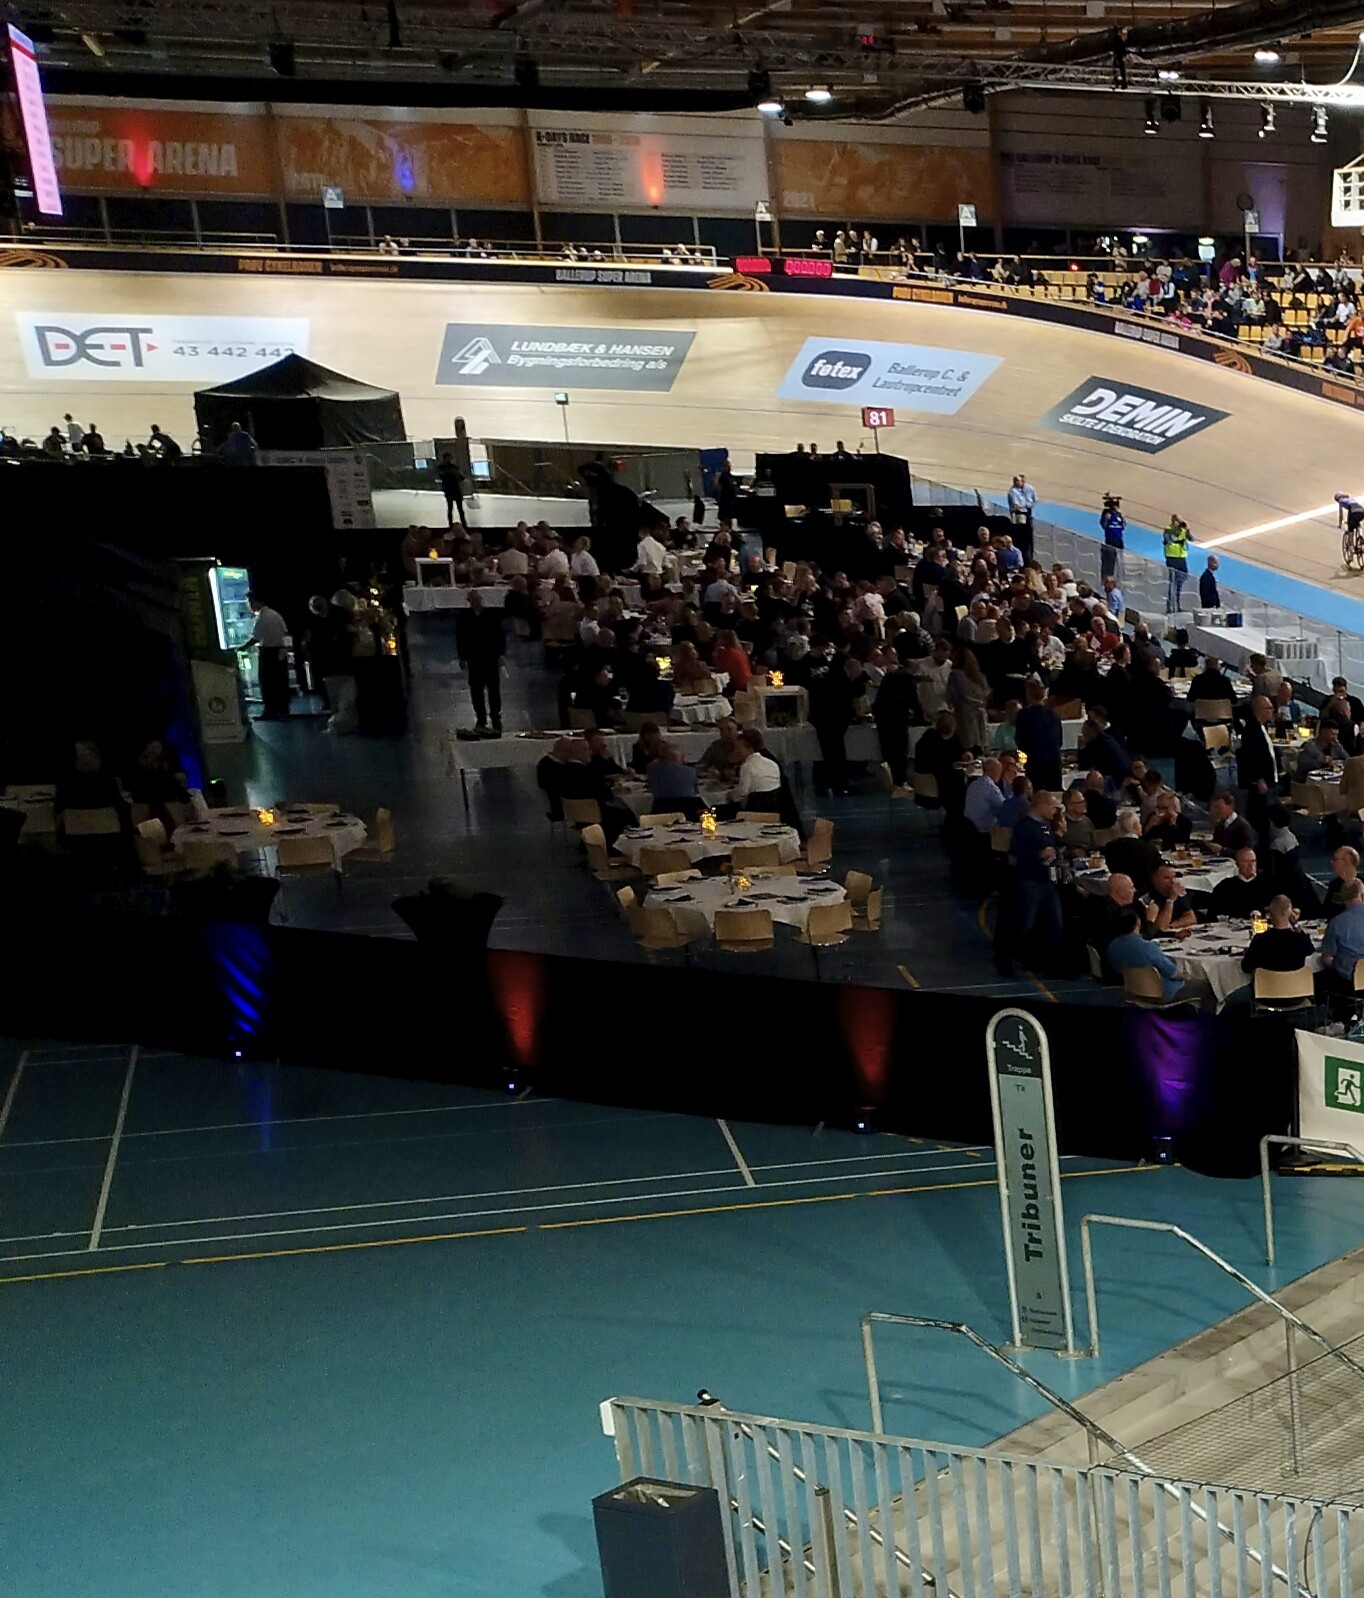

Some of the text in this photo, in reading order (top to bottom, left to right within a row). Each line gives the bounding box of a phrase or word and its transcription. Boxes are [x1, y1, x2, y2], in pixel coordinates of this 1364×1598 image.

[150, 141, 238, 177] ARENA
[173, 346, 199, 357] 43
[207, 347, 247, 358] 442
[594, 344, 606, 354] &
[608, 345, 675, 356] HANSEN
[869, 411, 887, 425] 81
[1070, 387, 1206, 437] DEMIN
[1017, 1127, 1043, 1263] Tribuner
